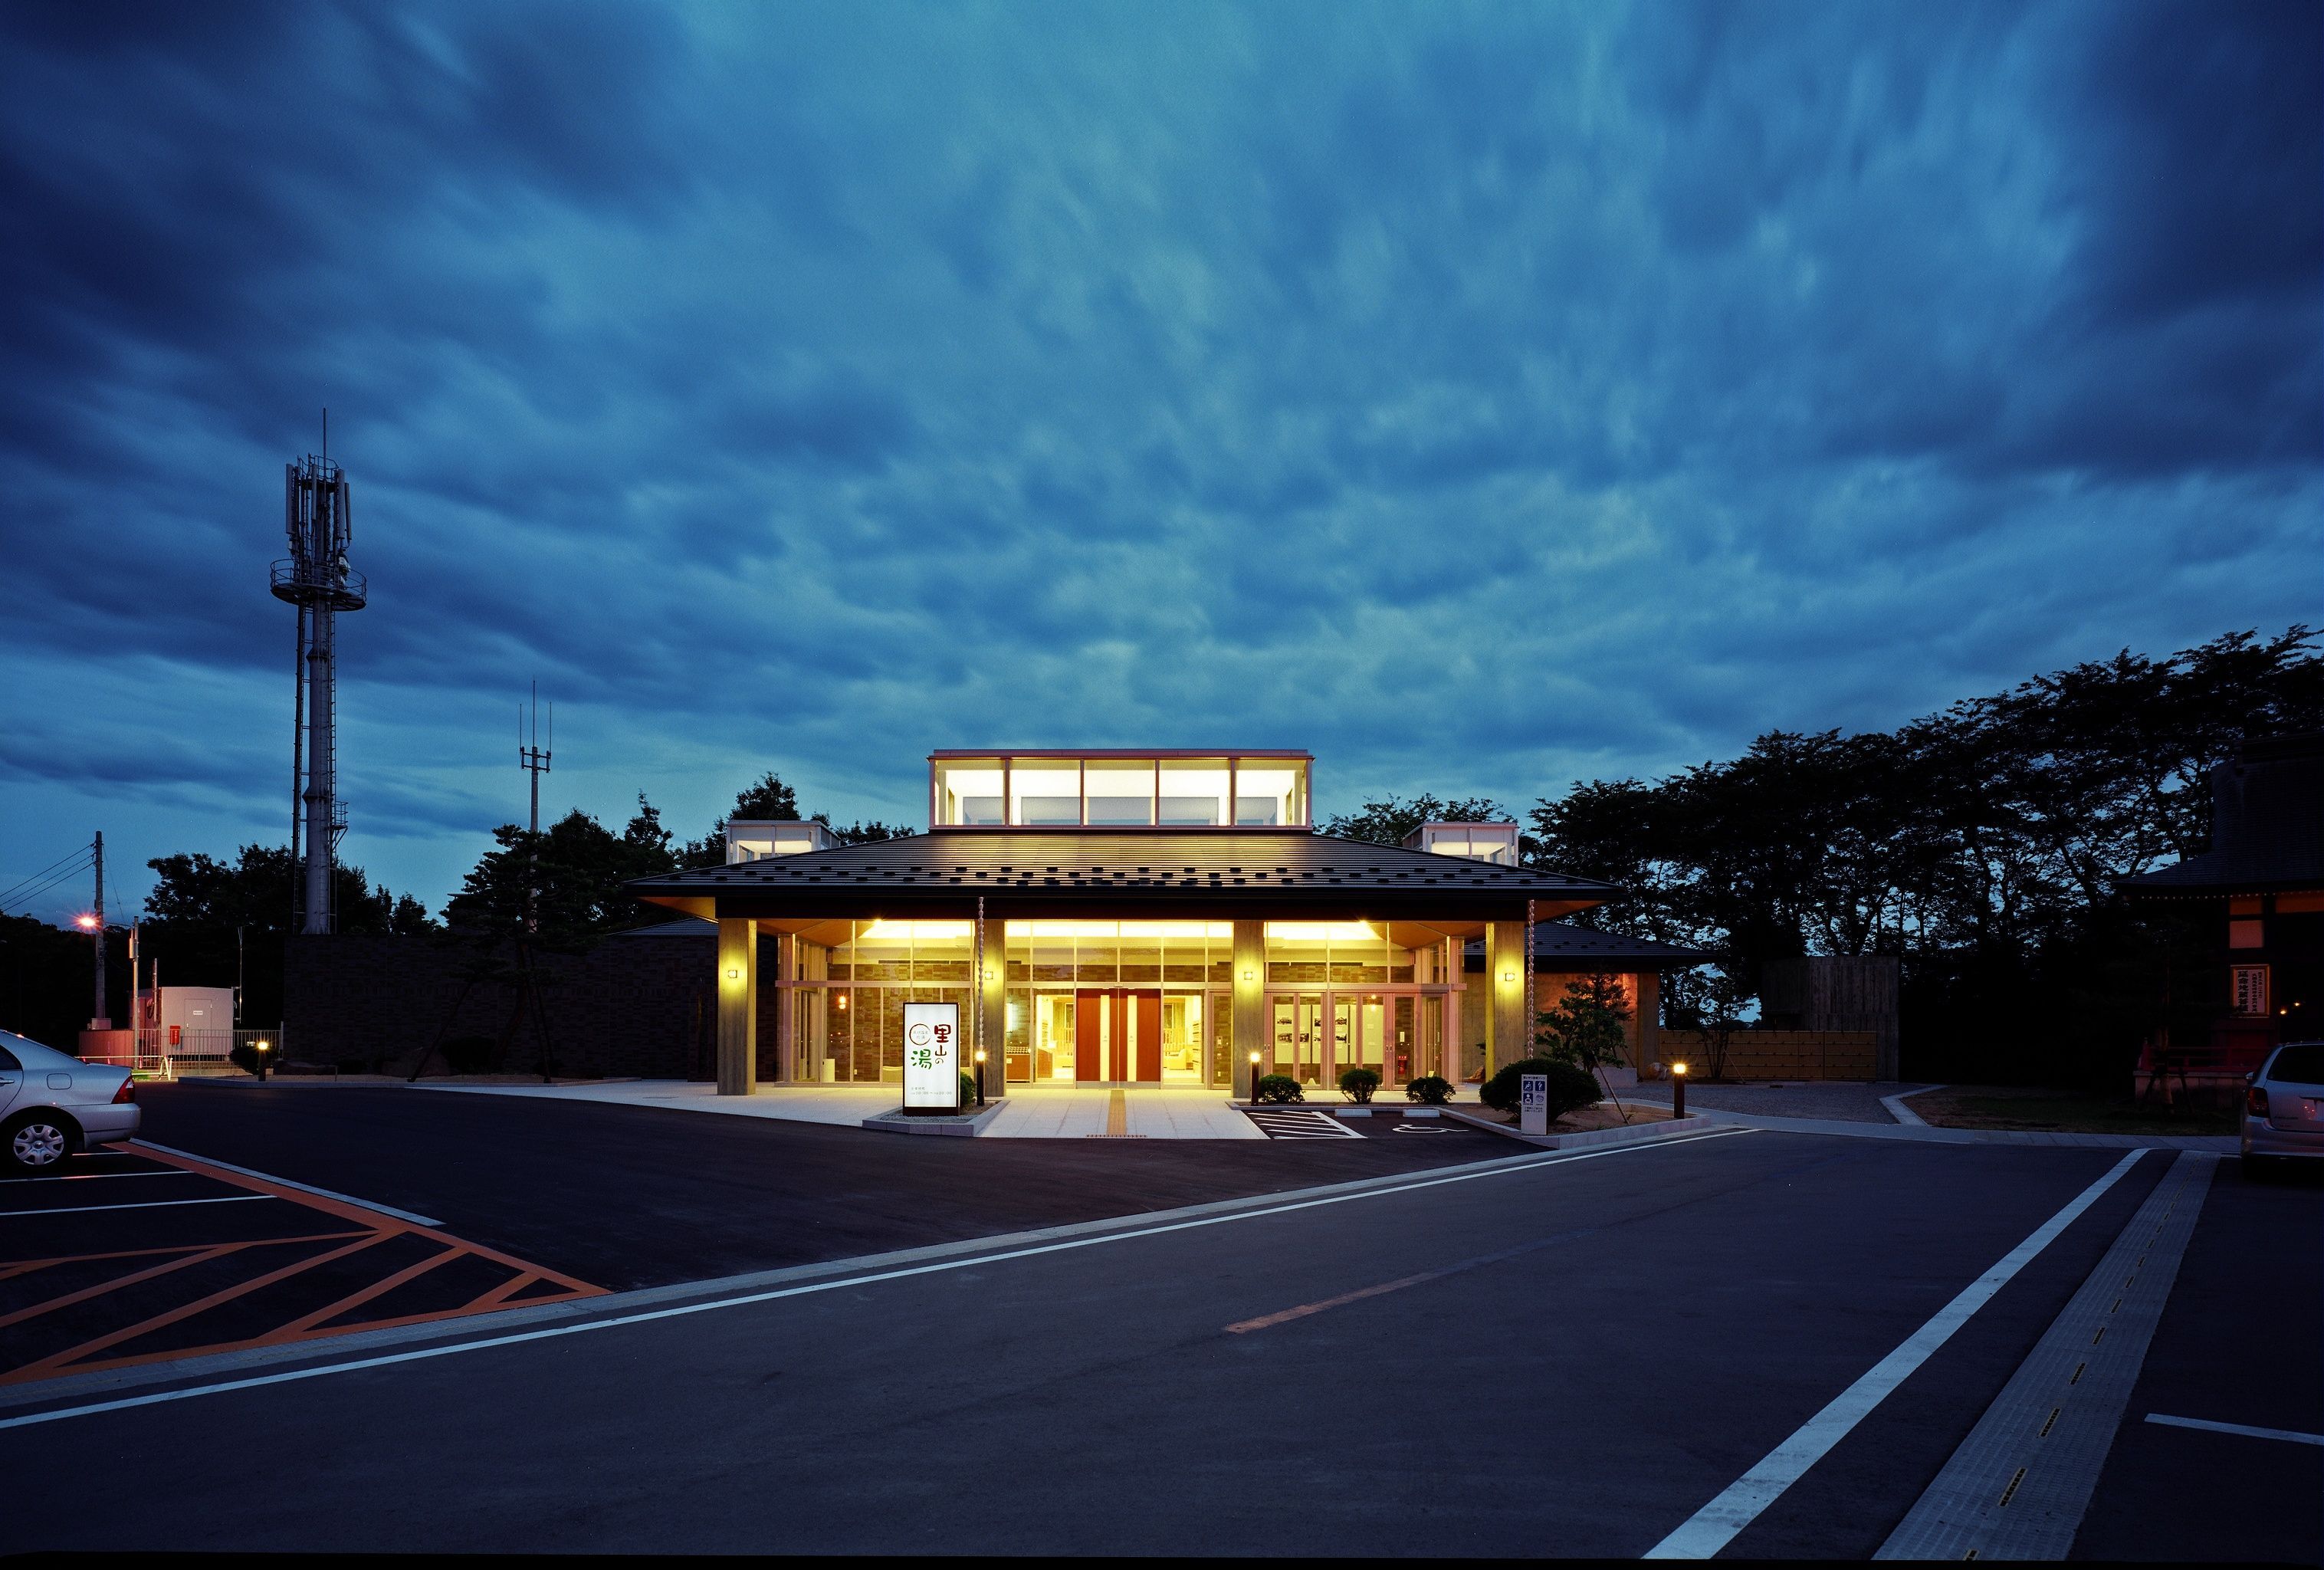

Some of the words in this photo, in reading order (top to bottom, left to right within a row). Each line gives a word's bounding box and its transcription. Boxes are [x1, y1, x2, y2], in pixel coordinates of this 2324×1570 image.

[911, 1049, 932, 1070] 湯
[934, 1023, 951, 1065] 里山の
